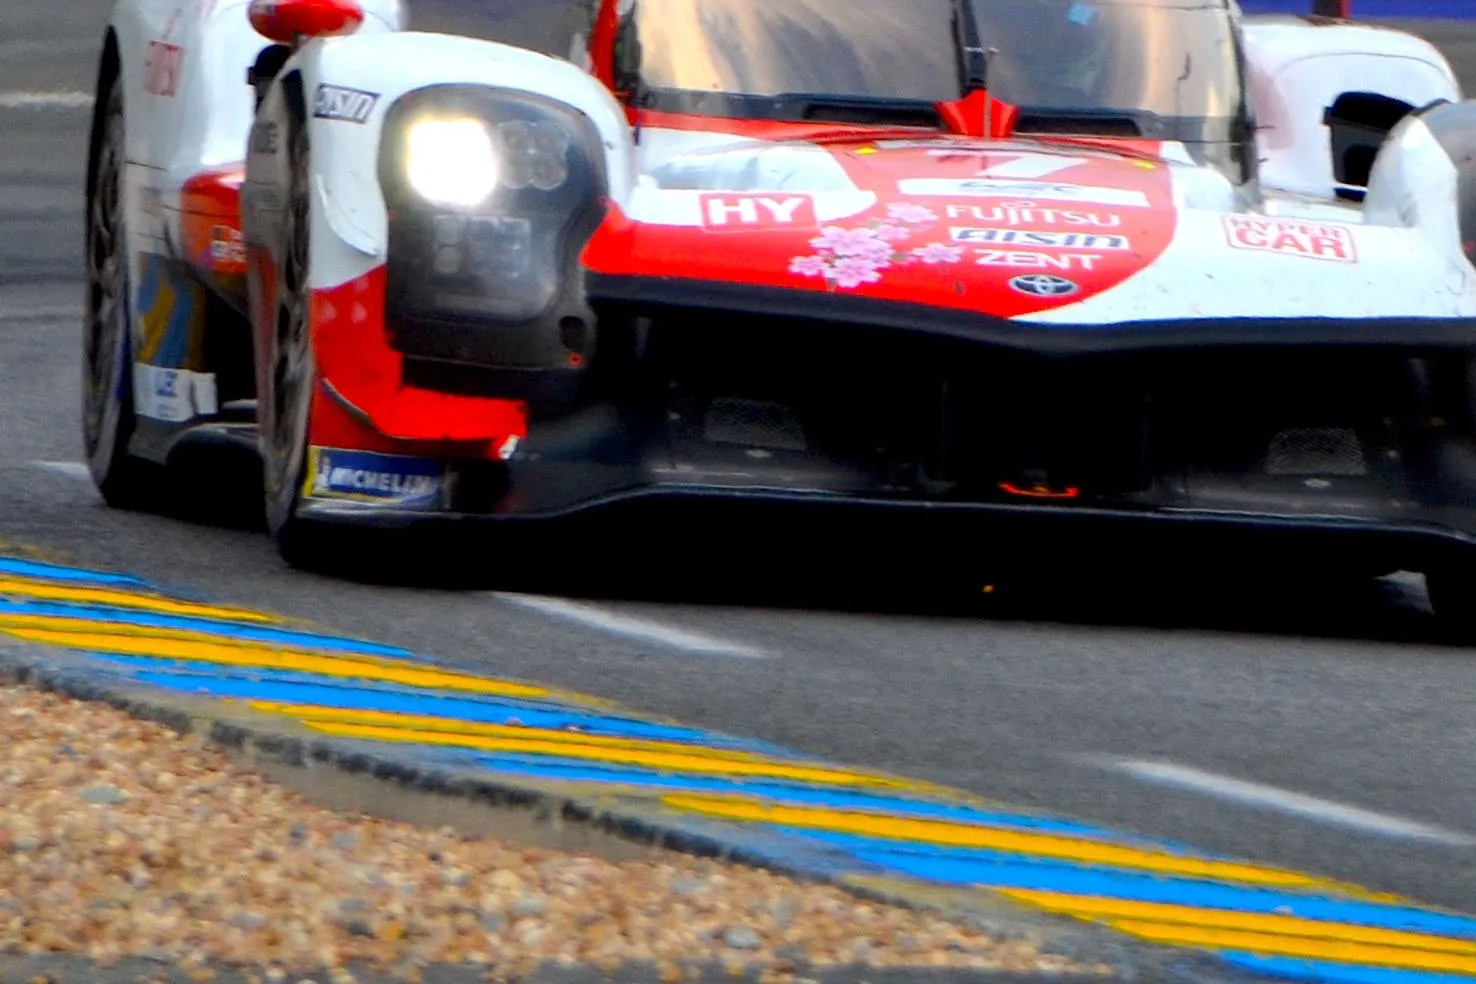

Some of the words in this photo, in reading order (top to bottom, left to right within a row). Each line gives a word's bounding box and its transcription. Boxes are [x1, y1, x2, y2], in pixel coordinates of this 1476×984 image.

[707, 197, 805, 225] HY
[946, 204, 1121, 227] FUJITSU
[1236, 228, 1347, 259] CAR
[973, 249, 1102, 269] ZENT
